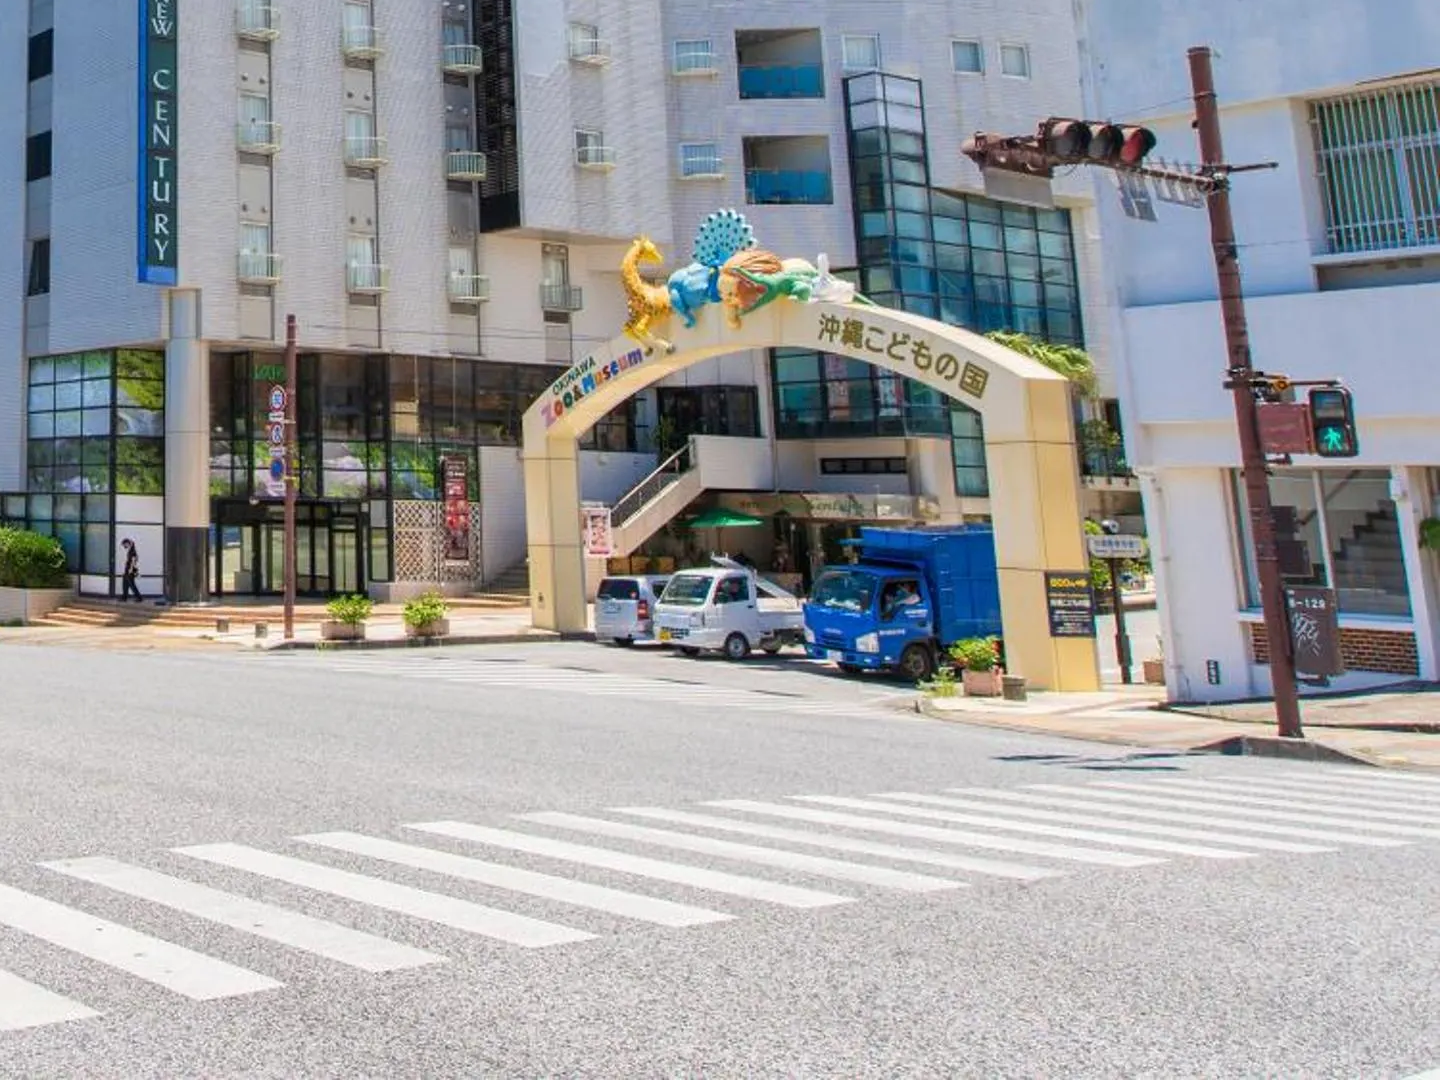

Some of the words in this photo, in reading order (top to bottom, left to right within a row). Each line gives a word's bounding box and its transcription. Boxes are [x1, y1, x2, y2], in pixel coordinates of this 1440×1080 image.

[152, 68, 171, 262] CENTURY
[552, 355, 597, 396] OKINAWA
[817, 312, 989, 400] 沖縄こどもの国
